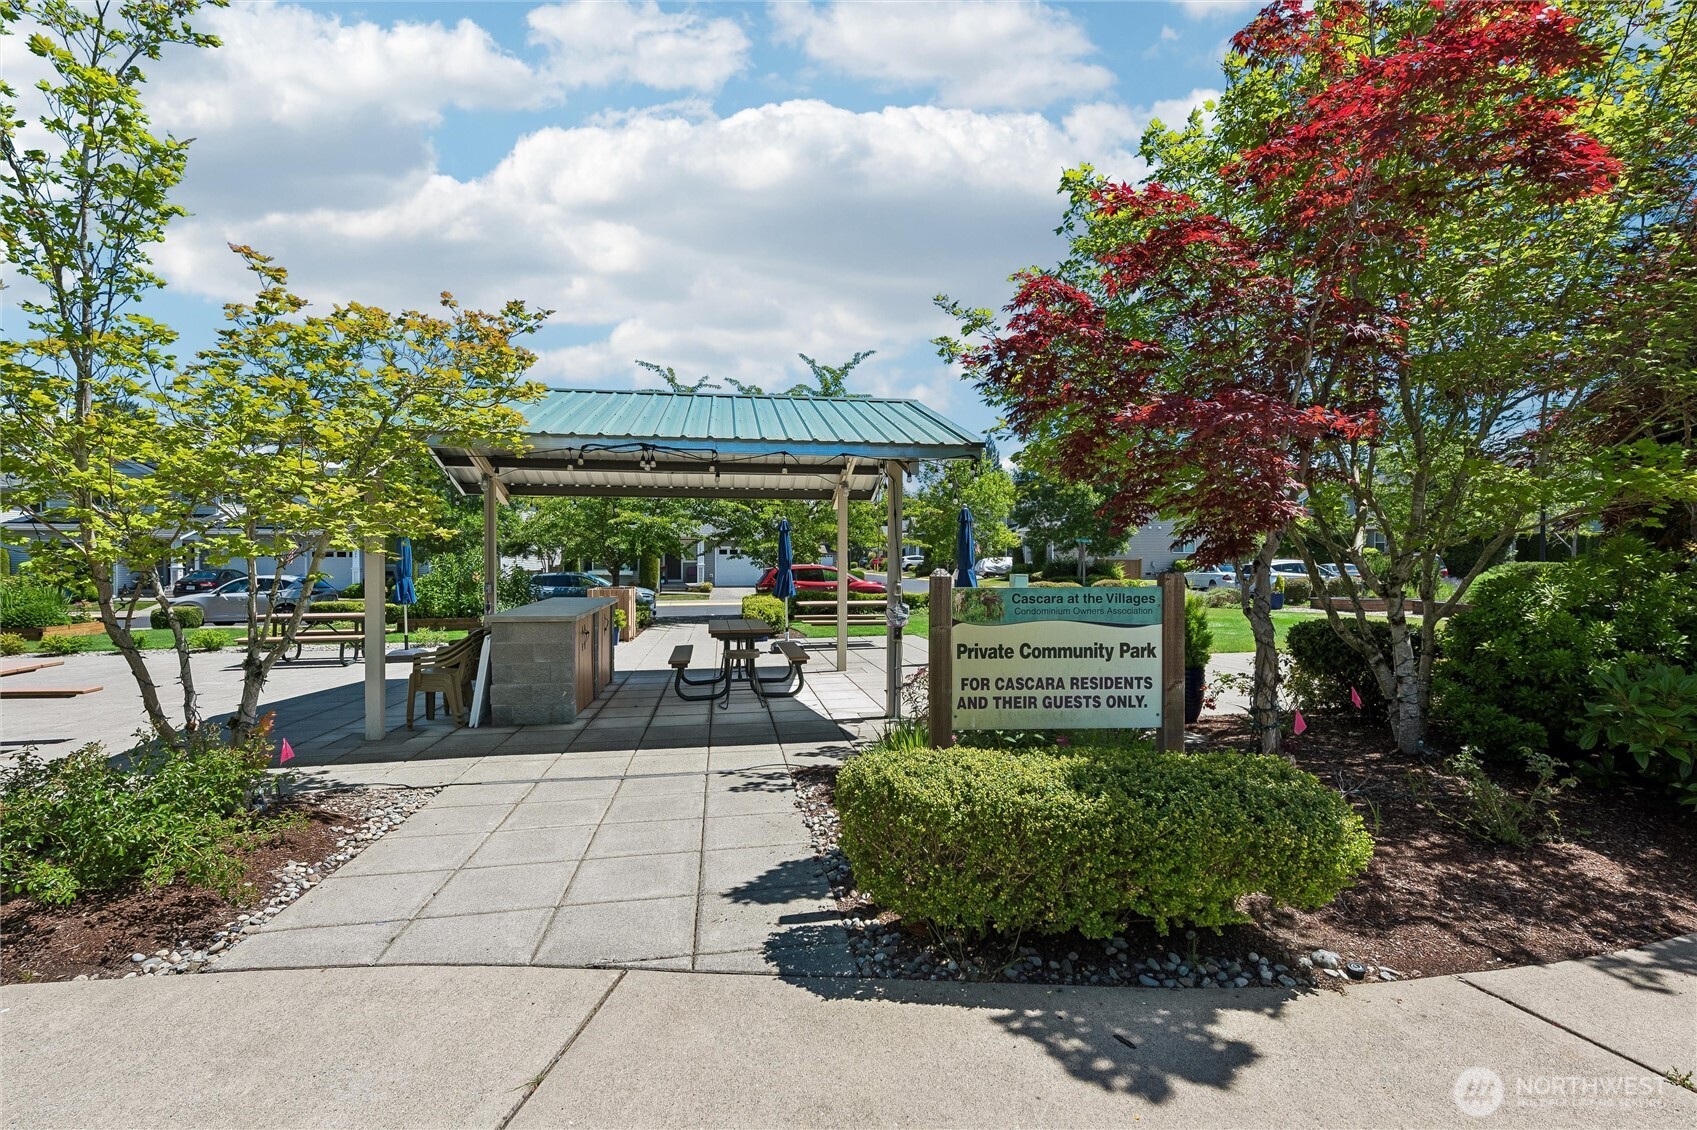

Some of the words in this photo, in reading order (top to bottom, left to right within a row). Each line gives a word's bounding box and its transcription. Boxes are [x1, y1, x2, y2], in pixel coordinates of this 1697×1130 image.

[1012, 593, 1063, 604] Cascara
[1068, 594, 1080, 603] at
[1083, 593, 1102, 603] the
[1106, 593, 1155, 606] Villages
[1014, 607, 1071, 615] Condominium
[1073, 607, 1105, 615] Owners
[957, 643, 1014, 659] Private
[1020, 643, 1114, 662] Community
[1120, 643, 1156, 658] Park
[961, 678, 990, 690] FOR
[995, 677, 1065, 690] CASCARA
[1070, 677, 1153, 689] RESIDENTS
[957, 696, 988, 709] AND
[993, 696, 1037, 708] THEIR
[1042, 695, 1101, 708] GUESTS
[1106, 695, 1148, 708] ONLY.
